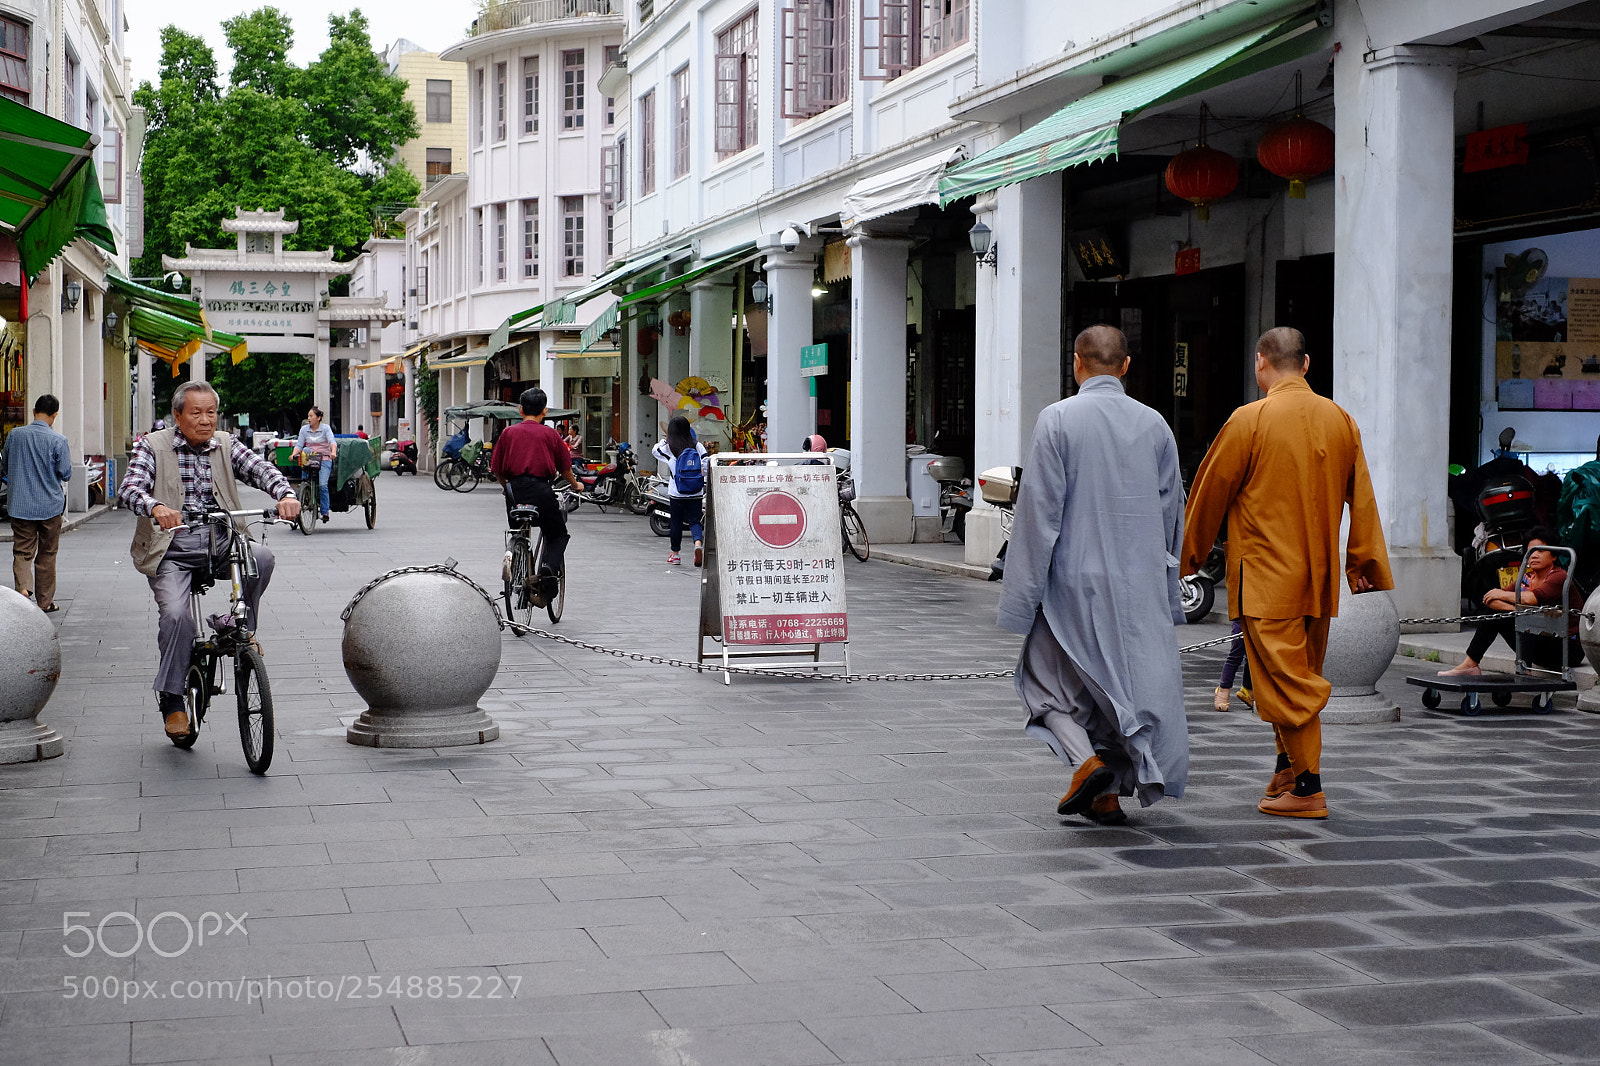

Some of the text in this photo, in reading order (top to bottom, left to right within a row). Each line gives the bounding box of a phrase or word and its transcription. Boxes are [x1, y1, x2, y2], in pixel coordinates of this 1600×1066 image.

[1174, 343, 1187, 395] 复印
[719, 474, 831, 484] 应急路口禁止停放一切车辆
[736, 591, 832, 605] 禁止一切车辆进入
